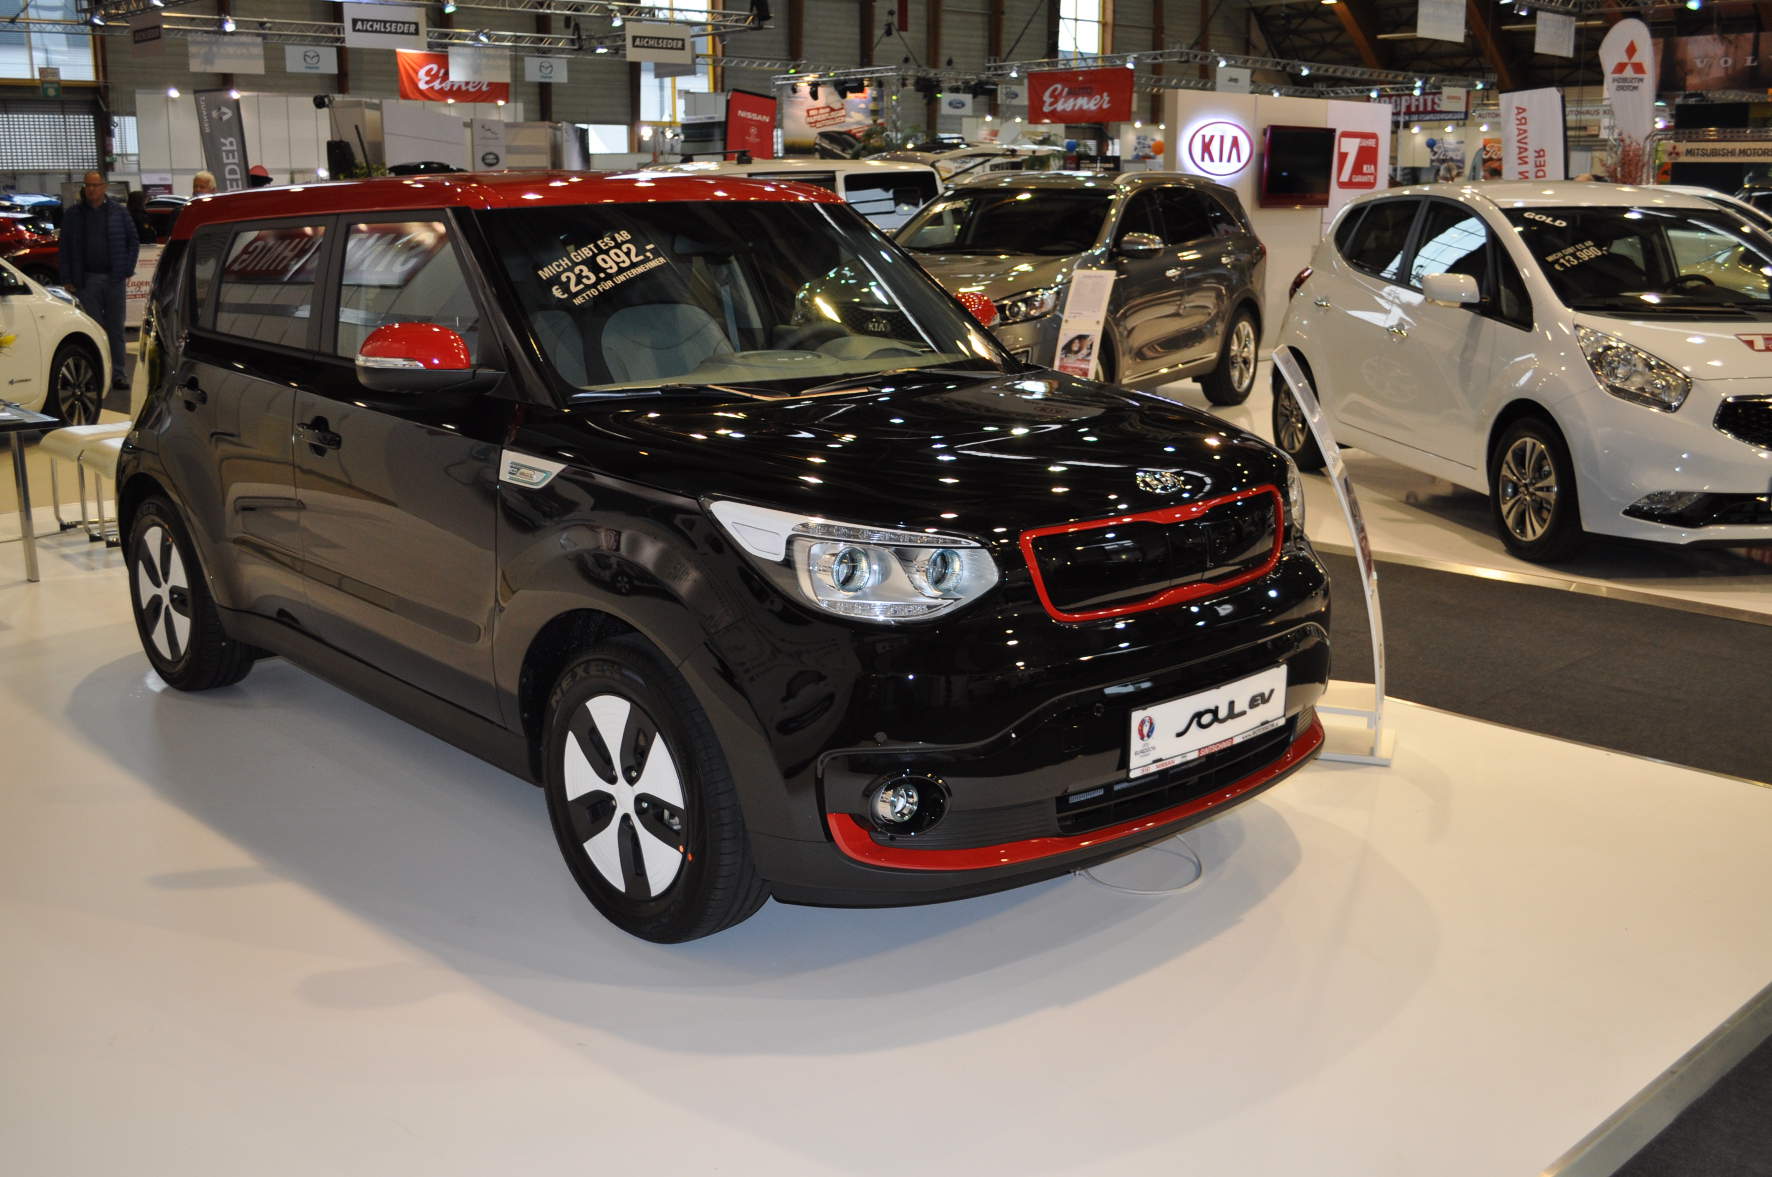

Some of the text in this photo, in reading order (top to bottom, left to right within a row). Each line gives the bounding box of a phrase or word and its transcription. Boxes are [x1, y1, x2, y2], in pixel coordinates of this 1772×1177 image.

[1043, 83, 1111, 112] Eisner
[737, 110, 770, 123] NISSAN
[1200, 134, 1242, 163] KIA
[1339, 137, 1362, 183] 7
[1685, 148, 1736, 158] MITSUBISHI
[1523, 211, 1568, 228] GOLD
[537, 229, 632, 281] MICH GIBT ES AB
[551, 284, 569, 300] €
[573, 256, 667, 306] NETTO FÜR UNTERNEHMER
